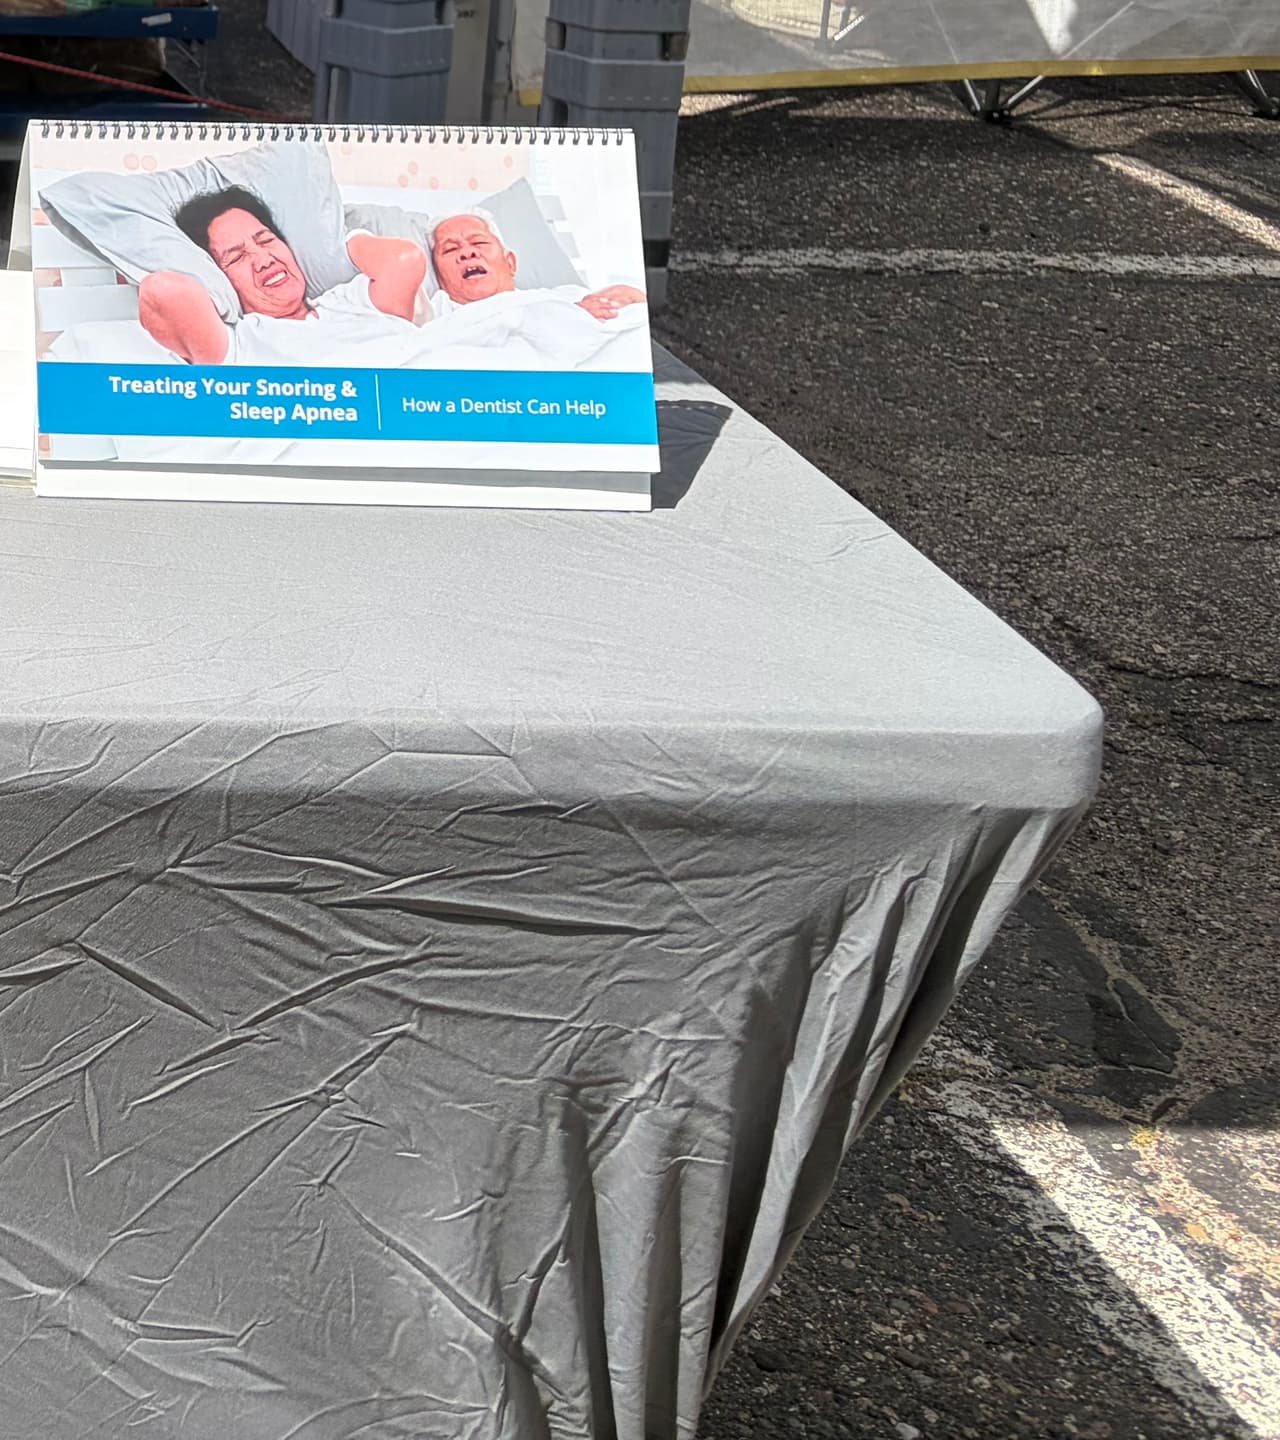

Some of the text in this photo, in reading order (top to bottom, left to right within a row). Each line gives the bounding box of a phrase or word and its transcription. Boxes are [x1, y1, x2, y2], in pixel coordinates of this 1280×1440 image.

[109, 376, 357, 400] Treating Your Snoring &
[230, 403, 358, 424] Sleep Apnea
[402, 396, 606, 419] How a Dentist Can Help
